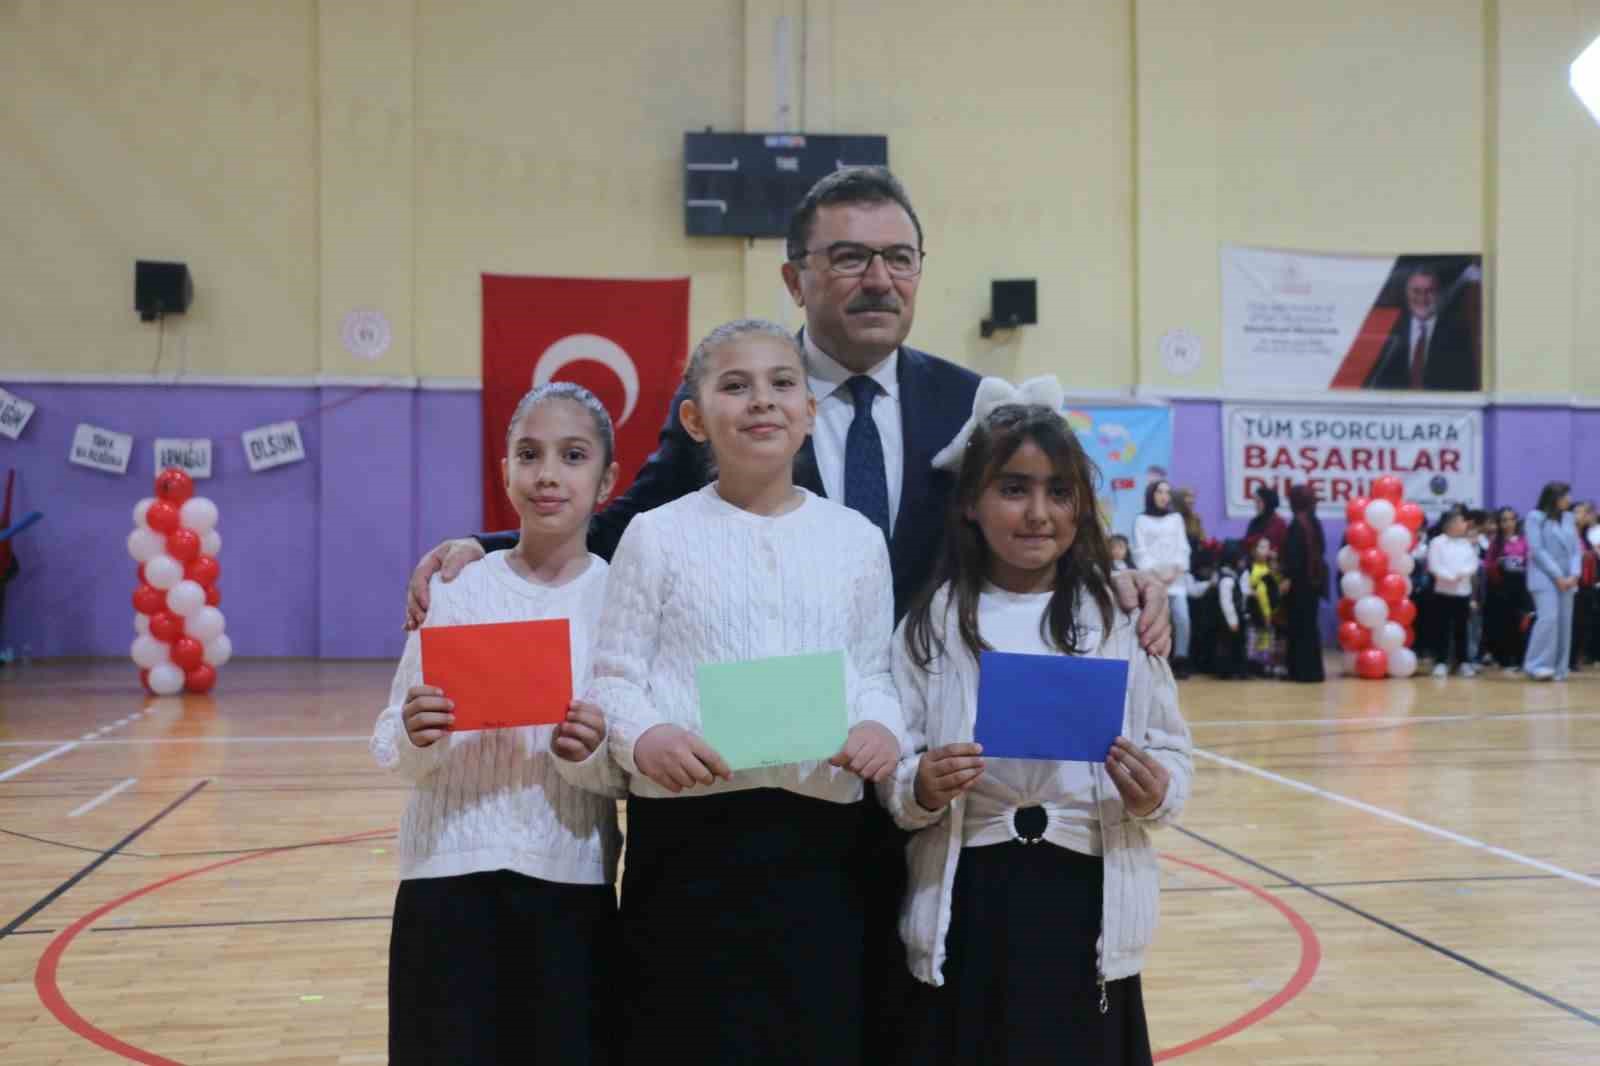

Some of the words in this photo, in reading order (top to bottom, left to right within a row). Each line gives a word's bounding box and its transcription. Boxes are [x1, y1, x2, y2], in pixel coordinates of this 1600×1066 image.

[1244, 416, 1293, 438] TÜM
[1301, 420, 1460, 441] SPORCULARA
[250, 433, 298, 460] OLSUN
[1243, 444, 1461, 474] BAŞARILAR
